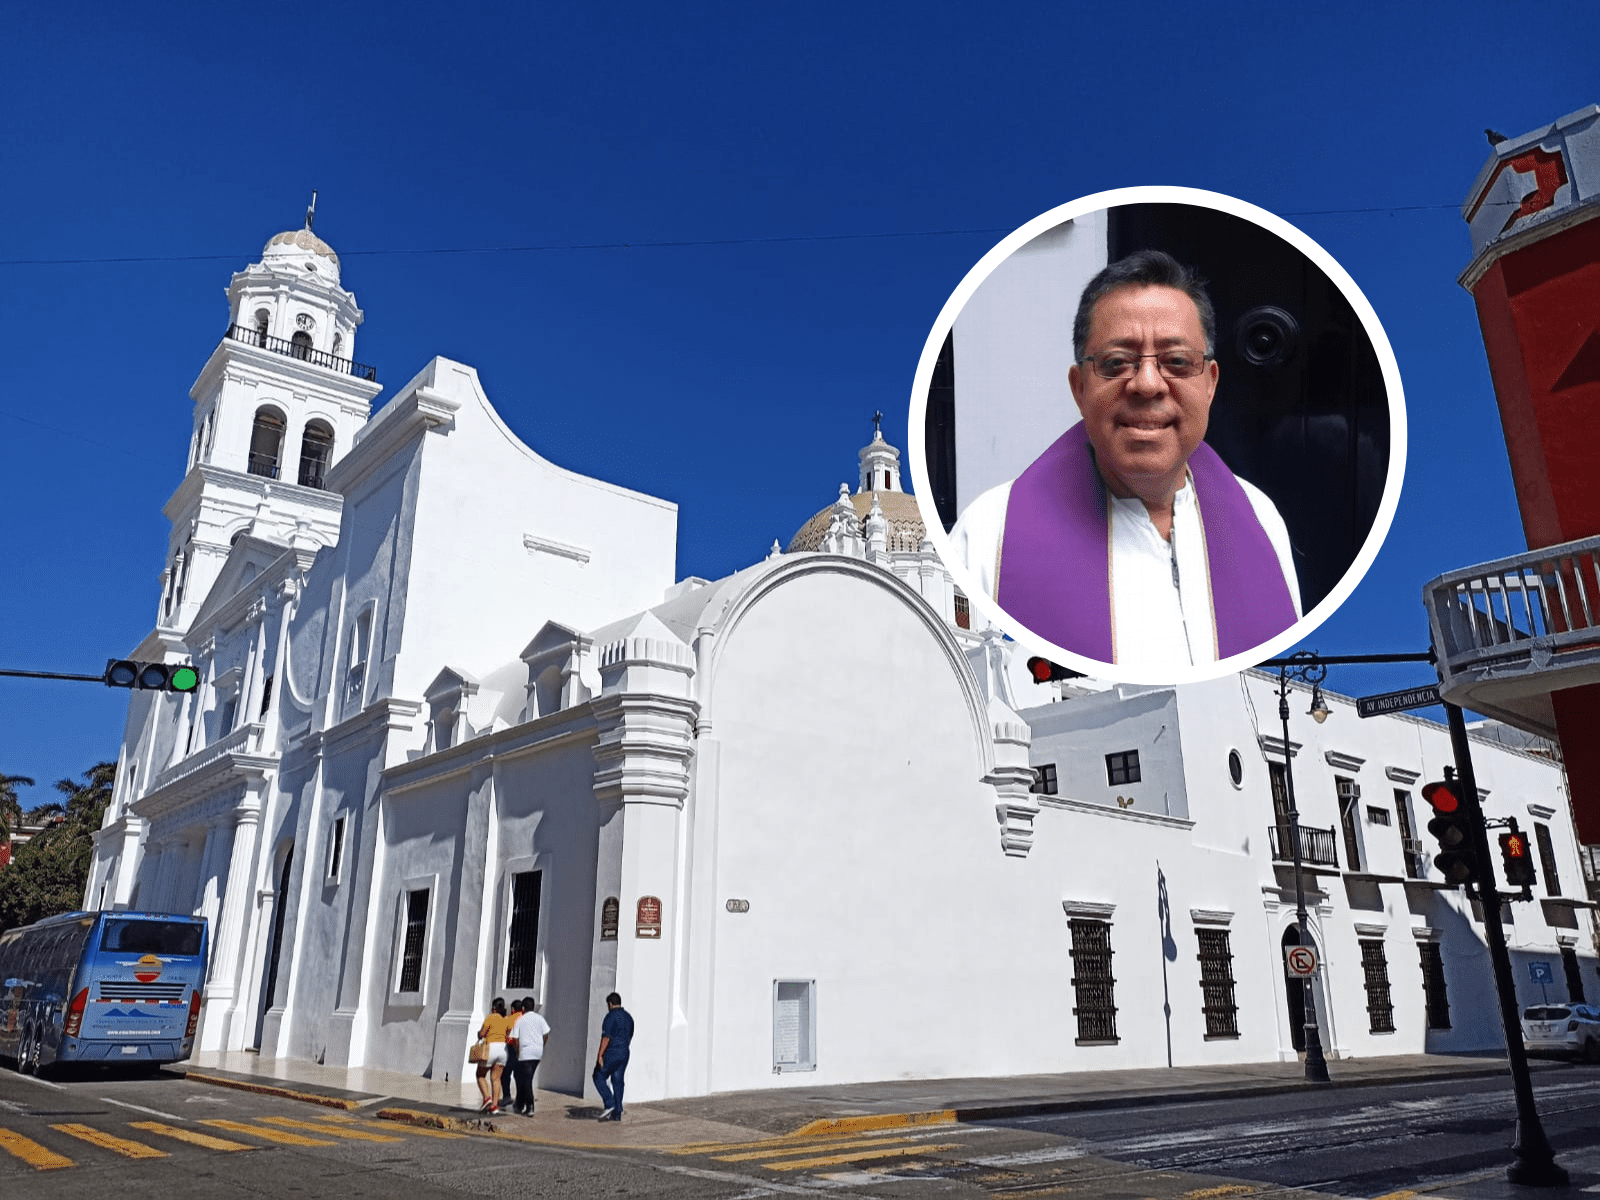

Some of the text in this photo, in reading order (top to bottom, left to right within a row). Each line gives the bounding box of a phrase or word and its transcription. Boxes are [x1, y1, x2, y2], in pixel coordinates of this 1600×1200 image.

[1366, 690, 1435, 711] AV INDEPENDENCIA
[1536, 969, 1544, 978] P
